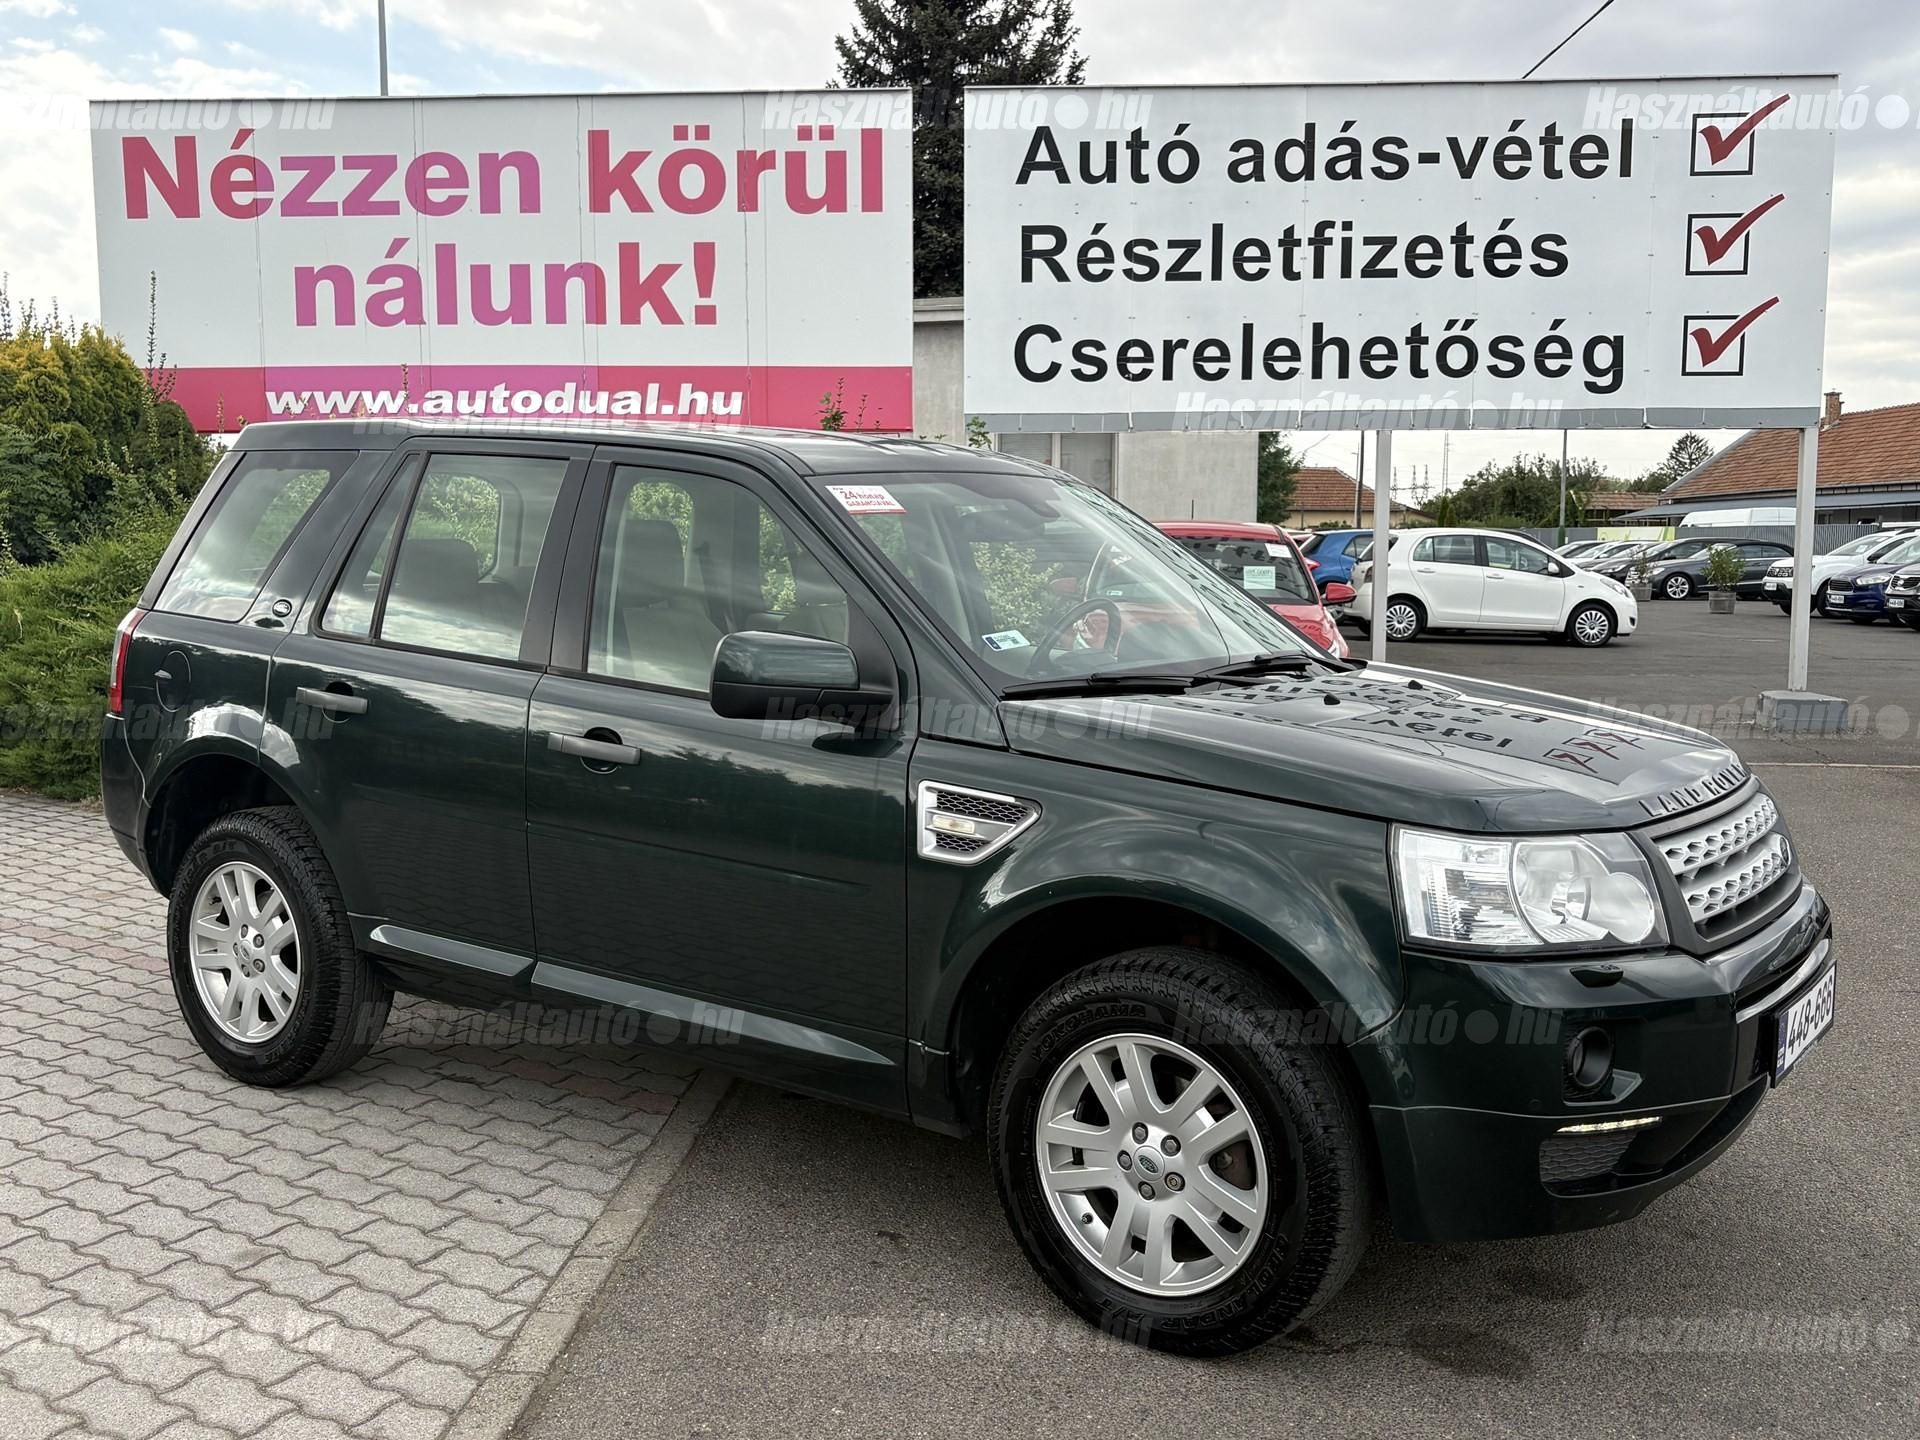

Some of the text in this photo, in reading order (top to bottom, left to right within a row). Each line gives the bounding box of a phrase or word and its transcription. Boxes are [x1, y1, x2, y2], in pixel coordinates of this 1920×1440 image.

[123, 124, 883, 219] Nézzen körül
[1016, 118, 1634, 185] Autó adás-vétel
[295, 238, 719, 327] nálunk!
[1020, 217, 1568, 283] Részletfizetés
[1014, 317, 1625, 395] Cserelehetőség
[265, 382, 744, 416] www.autodual.hu
[1638, 787, 1704, 818] LAND
[1788, 974, 1834, 1056] 448-666
